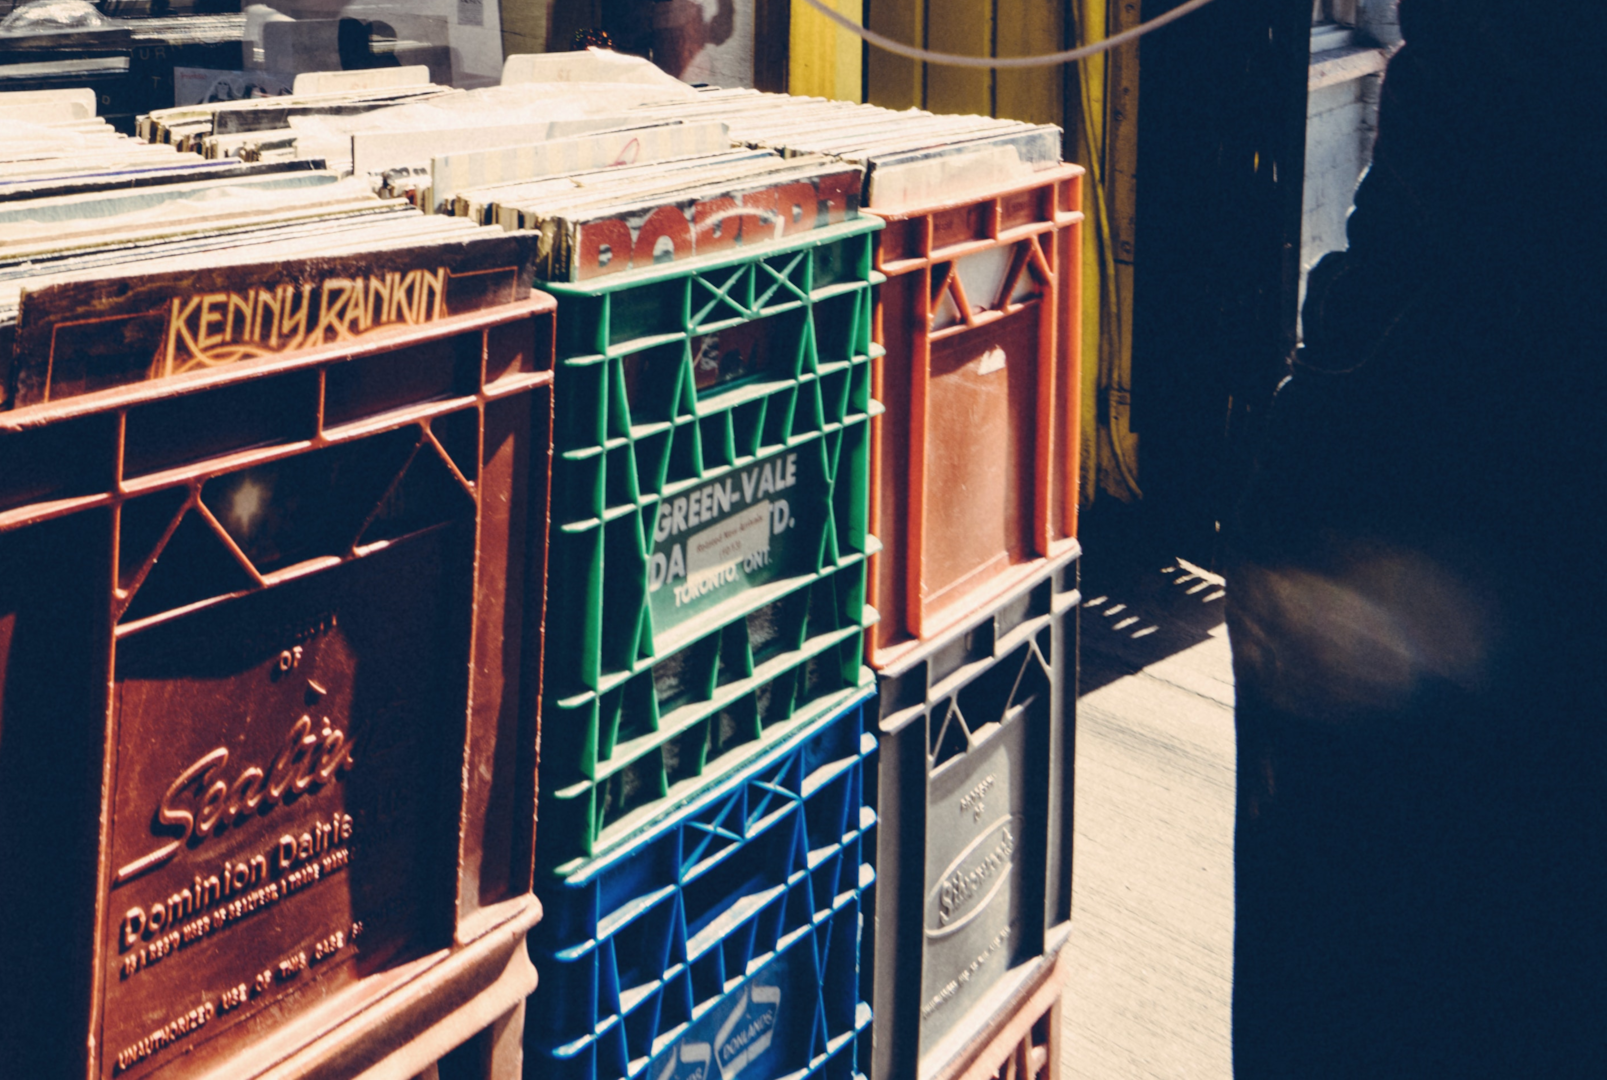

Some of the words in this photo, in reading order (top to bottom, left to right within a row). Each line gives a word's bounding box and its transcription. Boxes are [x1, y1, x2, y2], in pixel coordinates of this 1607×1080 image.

[164, 282, 312, 377] KENNY
[313, 267, 446, 348] RANKIN
[653, 452, 798, 543] GREEN-VALE
[278, 645, 304, 671] OF
[124, 854, 268, 948] Dominion
[221, 982, 248, 1010] USE
[254, 967, 273, 993] OF
